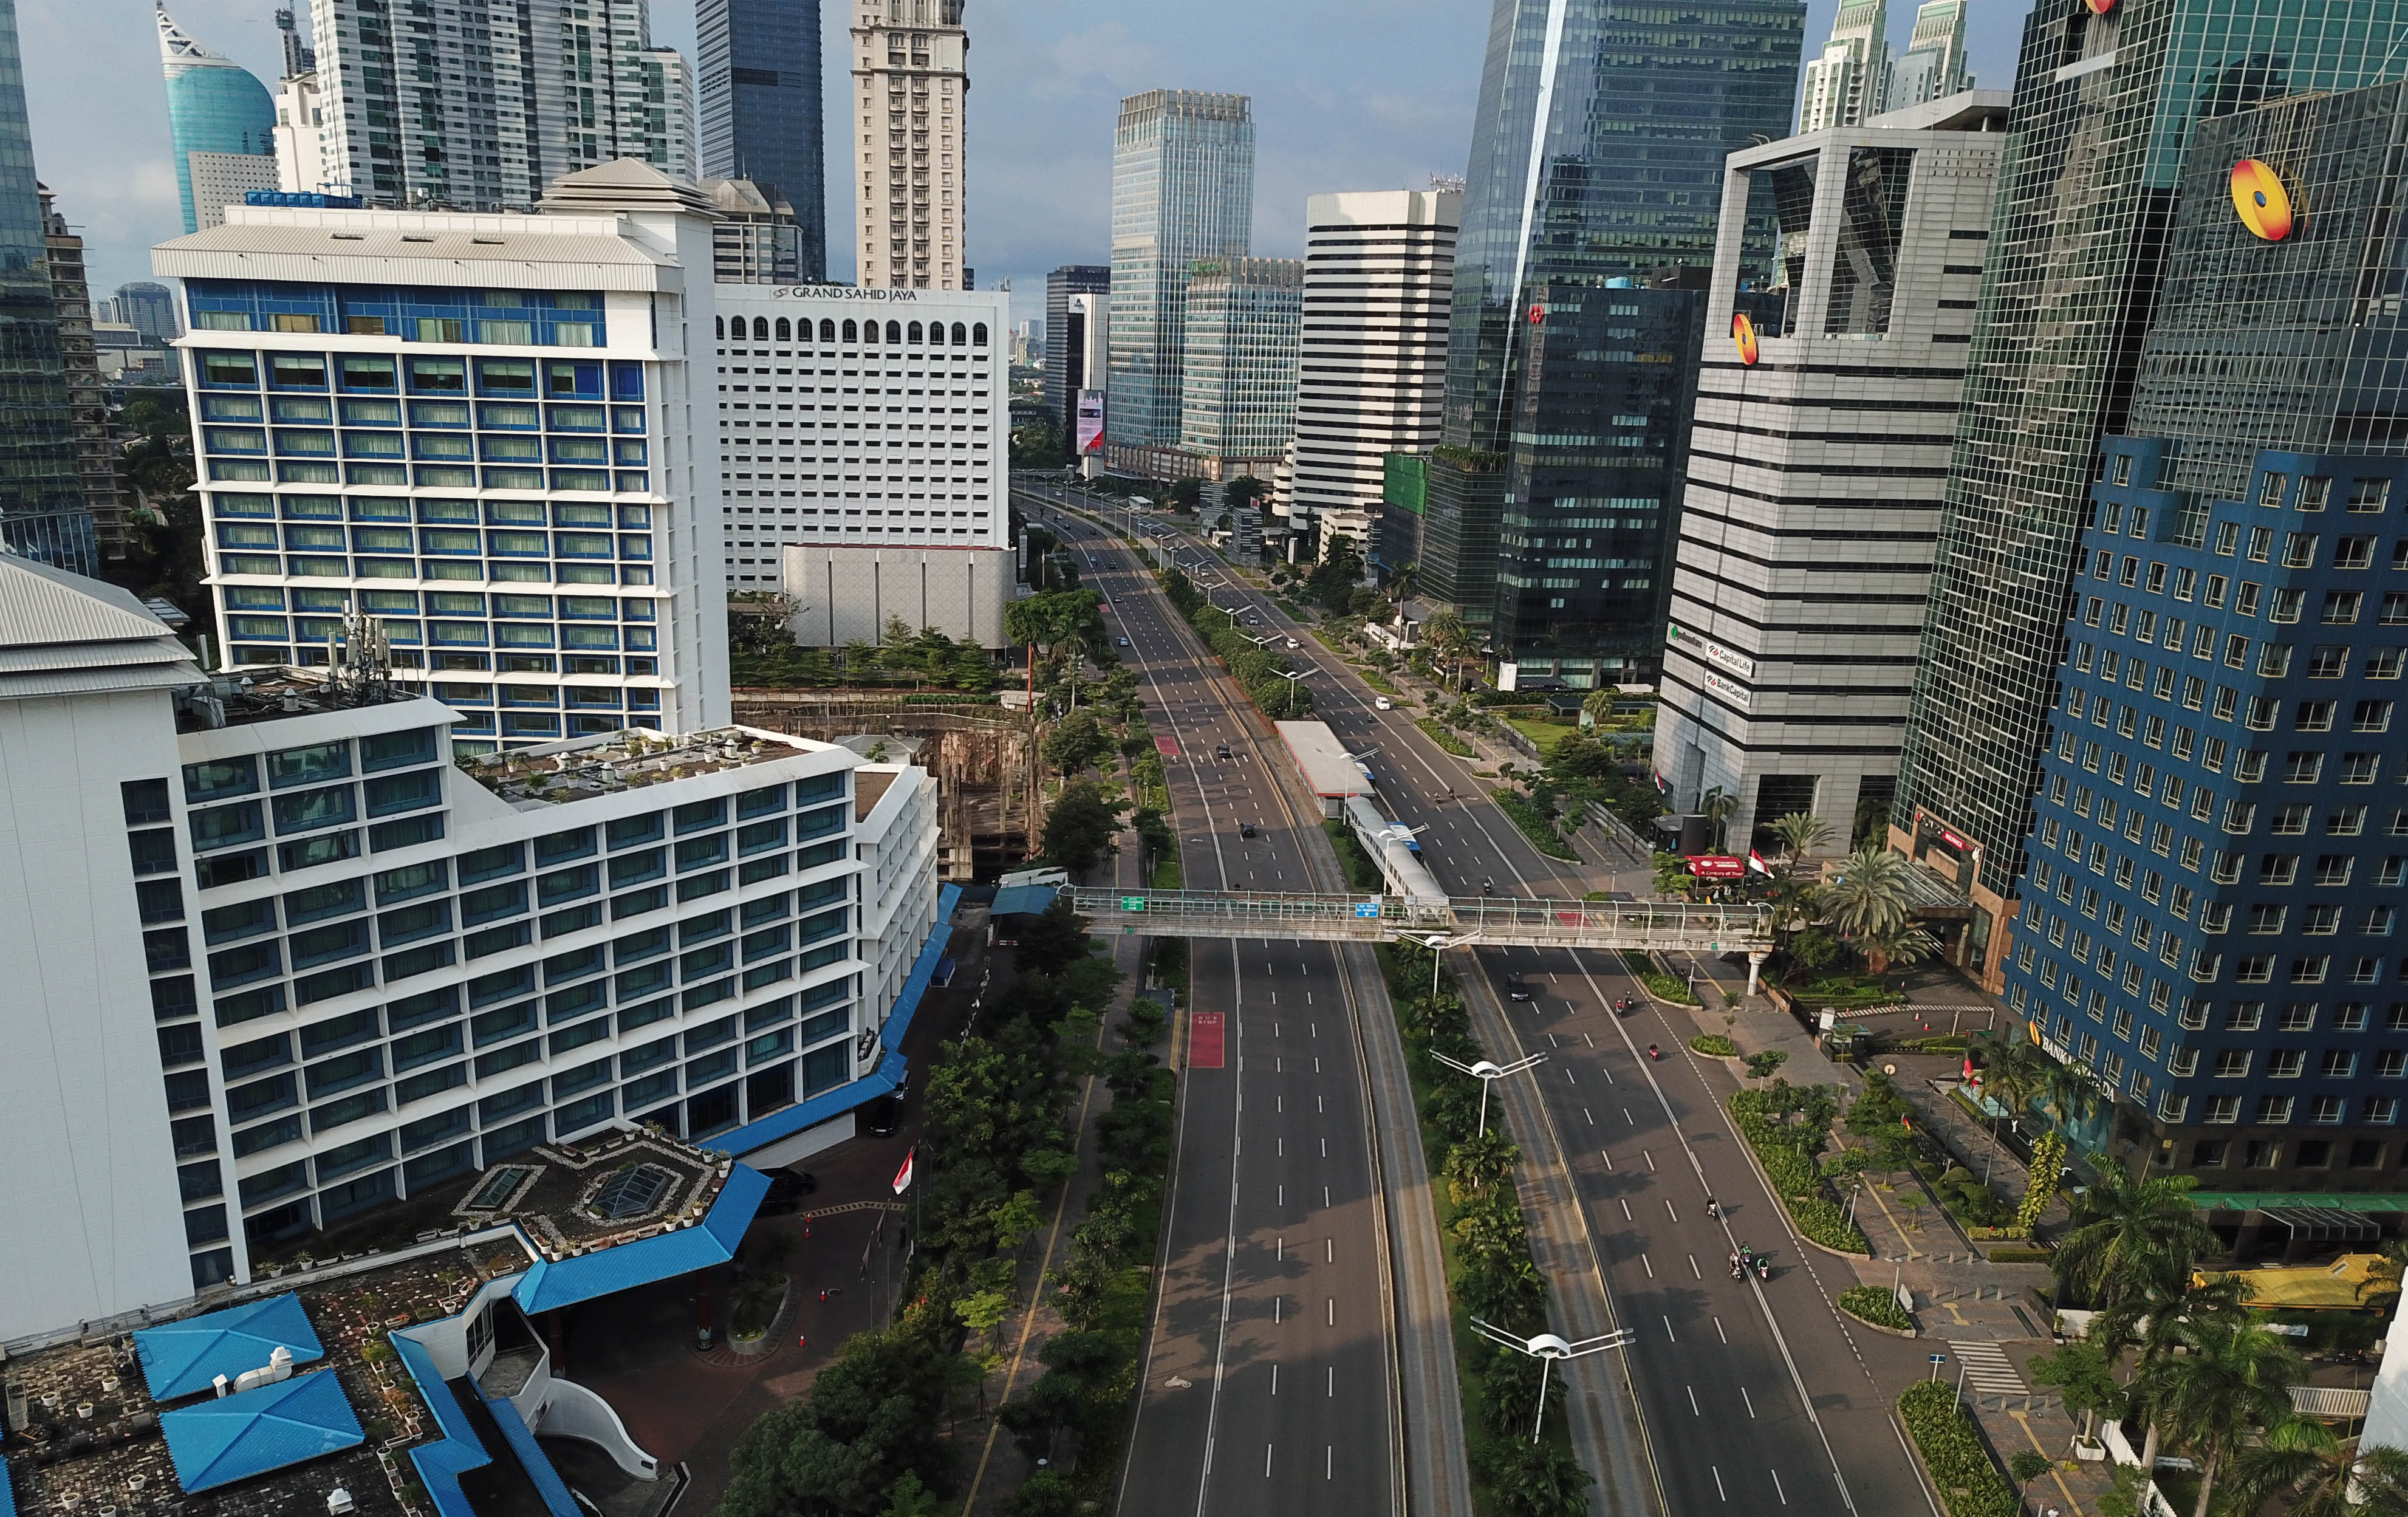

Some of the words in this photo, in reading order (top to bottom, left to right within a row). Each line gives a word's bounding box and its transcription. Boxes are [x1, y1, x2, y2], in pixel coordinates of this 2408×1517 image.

[792, 287, 843, 298] GRAND
[845, 289, 886, 300] SAHID
[889, 290, 917, 303] JAYA
[2042, 1035, 2067, 1066] BANK
